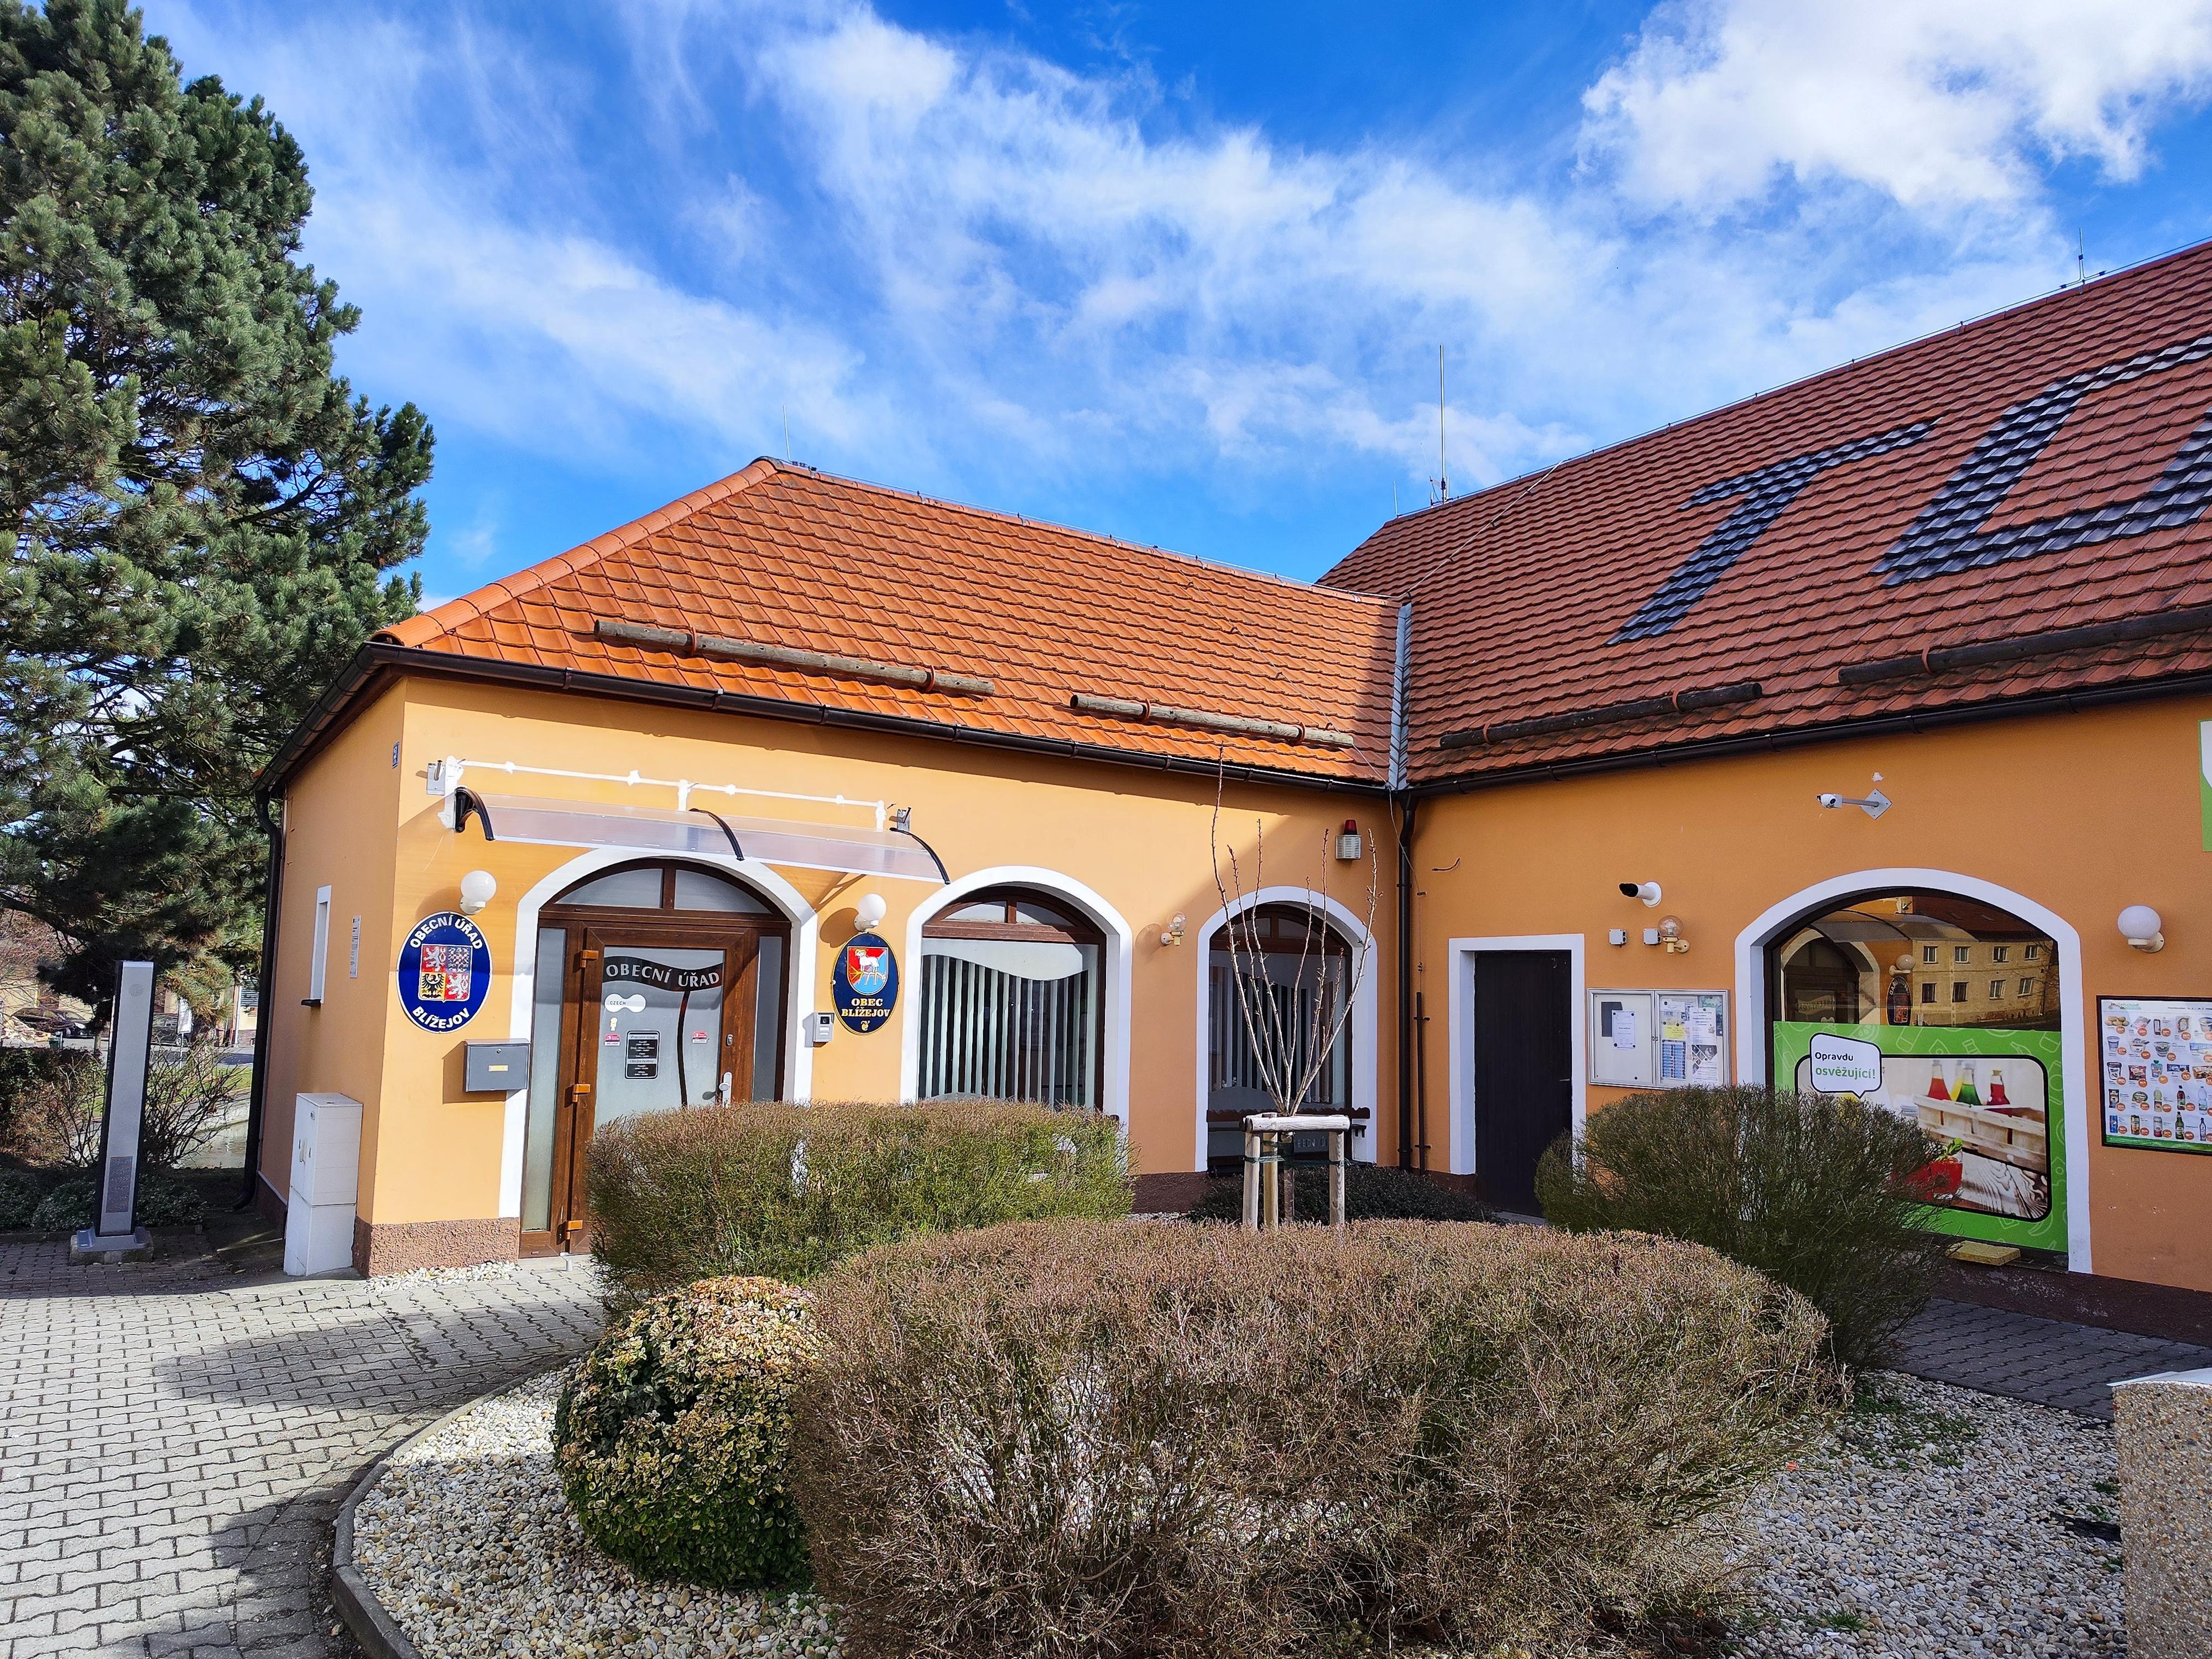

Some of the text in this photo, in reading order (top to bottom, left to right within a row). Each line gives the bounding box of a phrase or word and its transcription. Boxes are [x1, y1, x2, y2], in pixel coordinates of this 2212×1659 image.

[410, 914, 483, 950] OBECNÍ ÚŘAD
[606, 964, 720, 988] OBECNÍ ÚŘAD
[851, 998, 883, 1006] OBEC
[412, 1006, 470, 1029] BLÍŽEJOV
[841, 1006, 890, 1017] BLÍŽEJOV
[1815, 1052, 1854, 1061] Opravdu
[1815, 1066, 1875, 1080] osvěžující!
